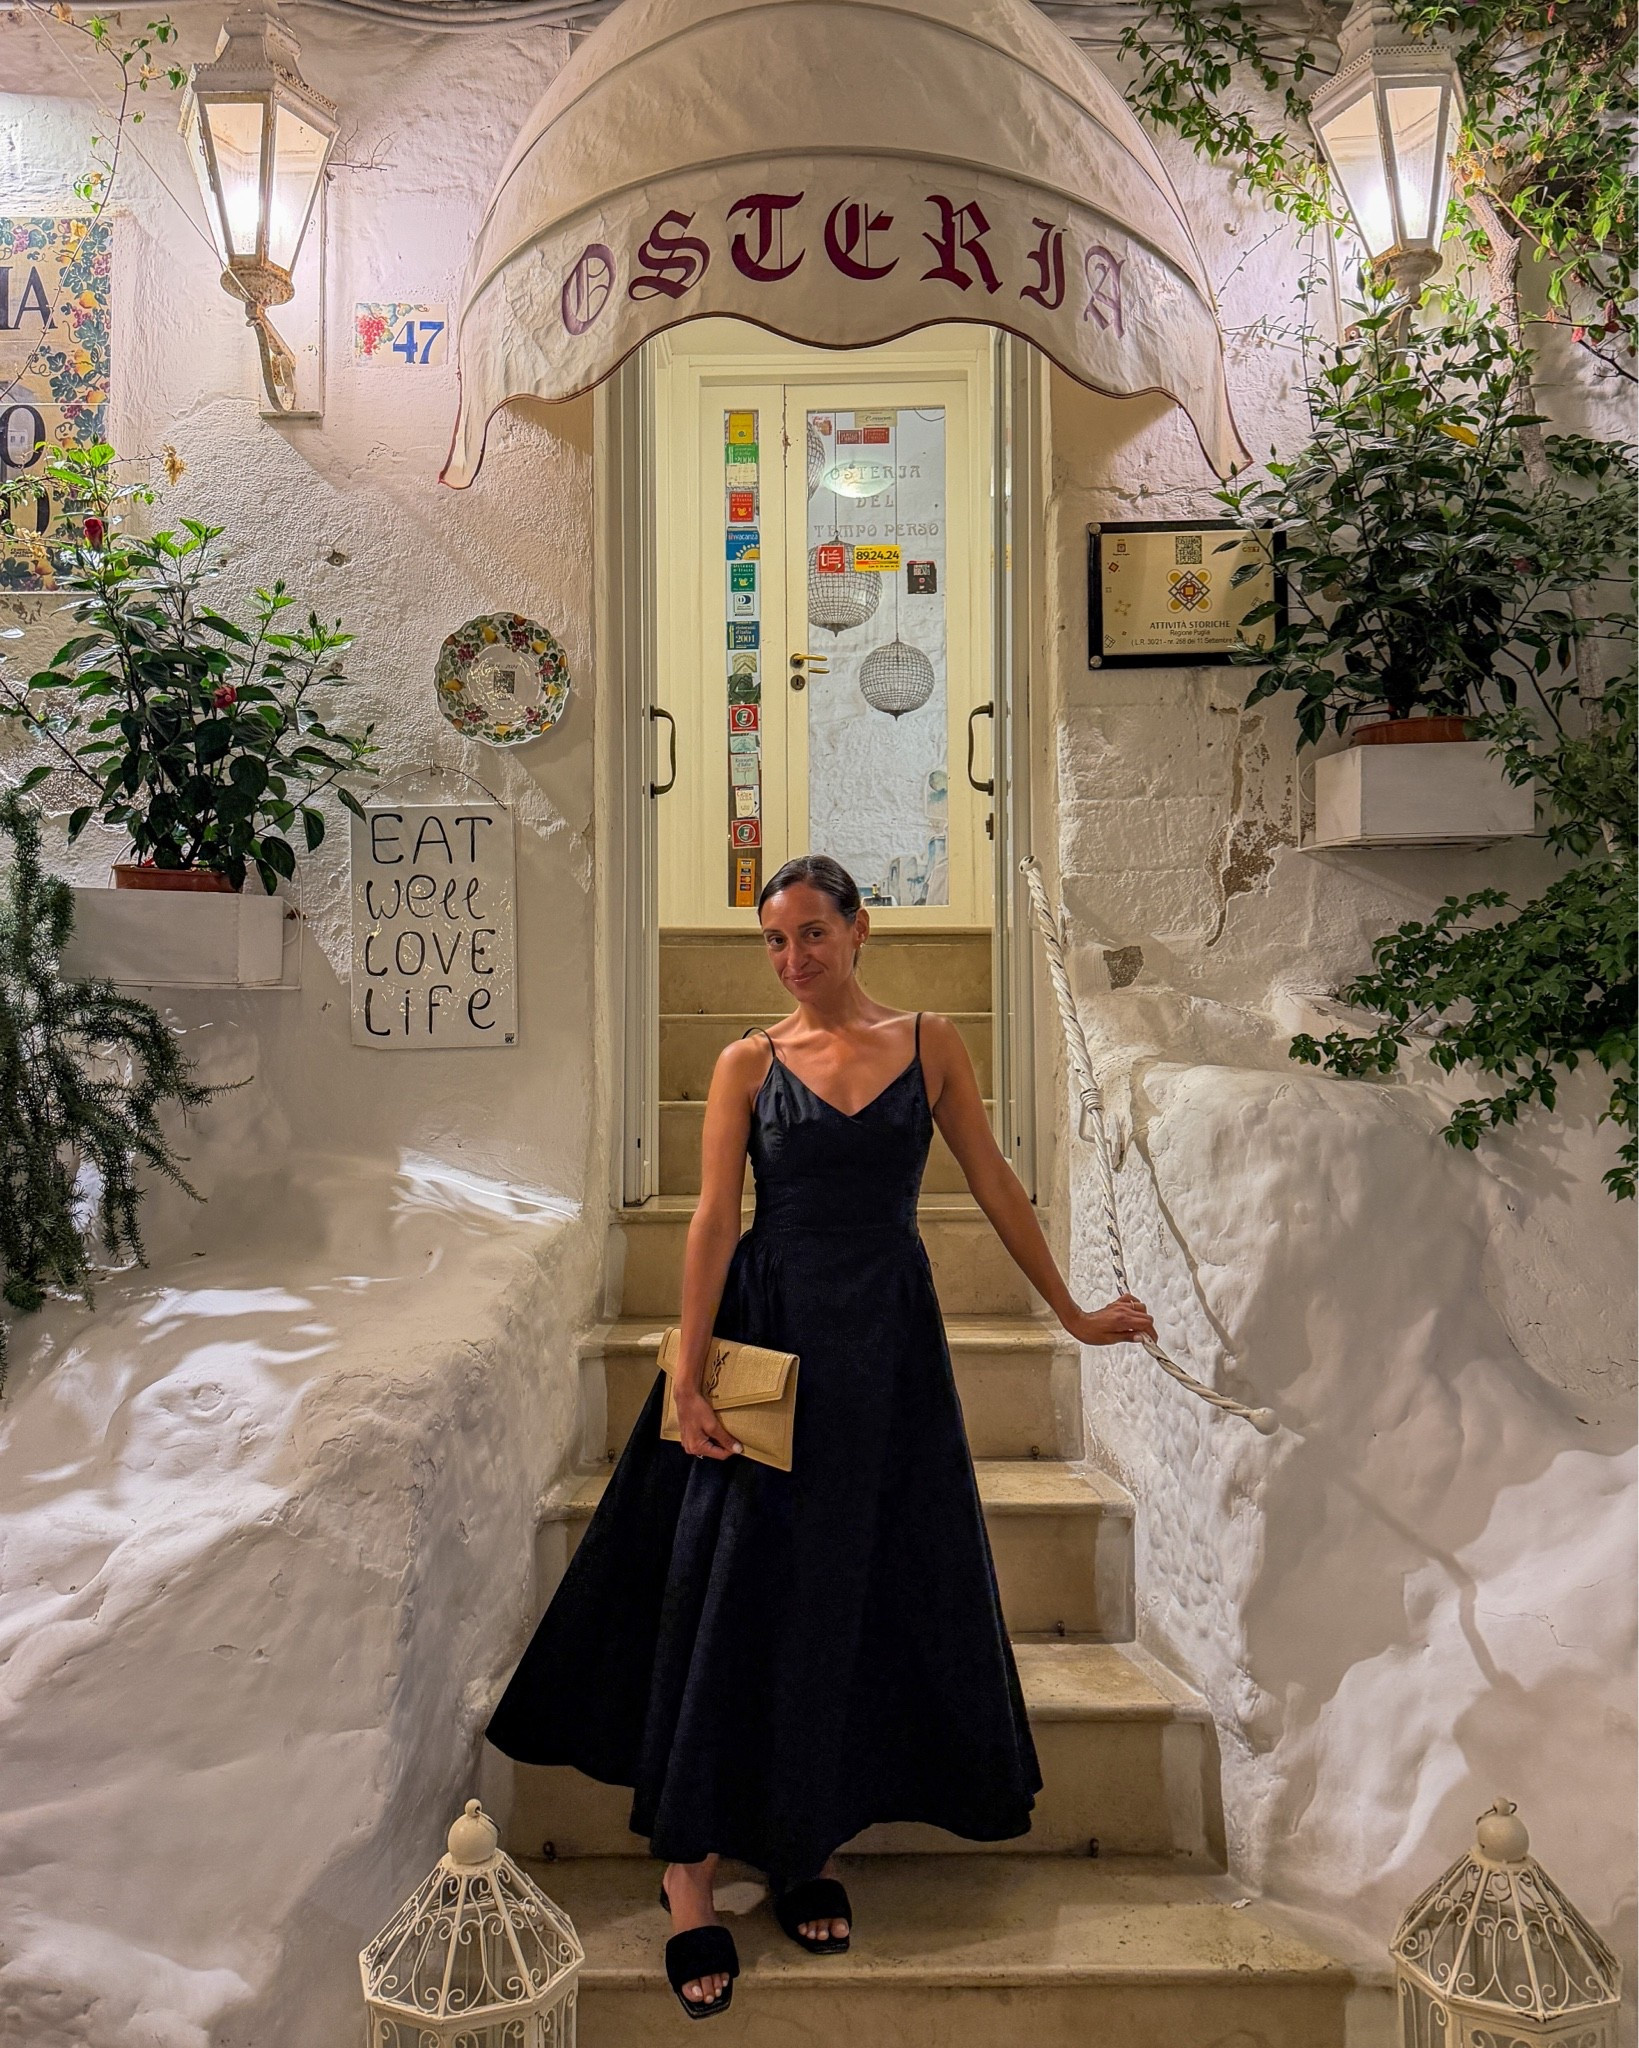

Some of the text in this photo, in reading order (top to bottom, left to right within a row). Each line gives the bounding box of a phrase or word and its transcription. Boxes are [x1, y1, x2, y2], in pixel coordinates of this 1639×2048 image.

[392, 320, 445, 365] 47
[855, 494, 894, 508] DEL
[813, 523, 939, 538] TEMPO PERSO
[855, 550, 900, 560] 89.24.24
[1149, 620, 1231, 630] ATTIVITÀ STORICHE
[735, 634, 755, 643] 2001
[370, 812, 494, 865] EAT
[364, 928, 496, 977] LOVE
